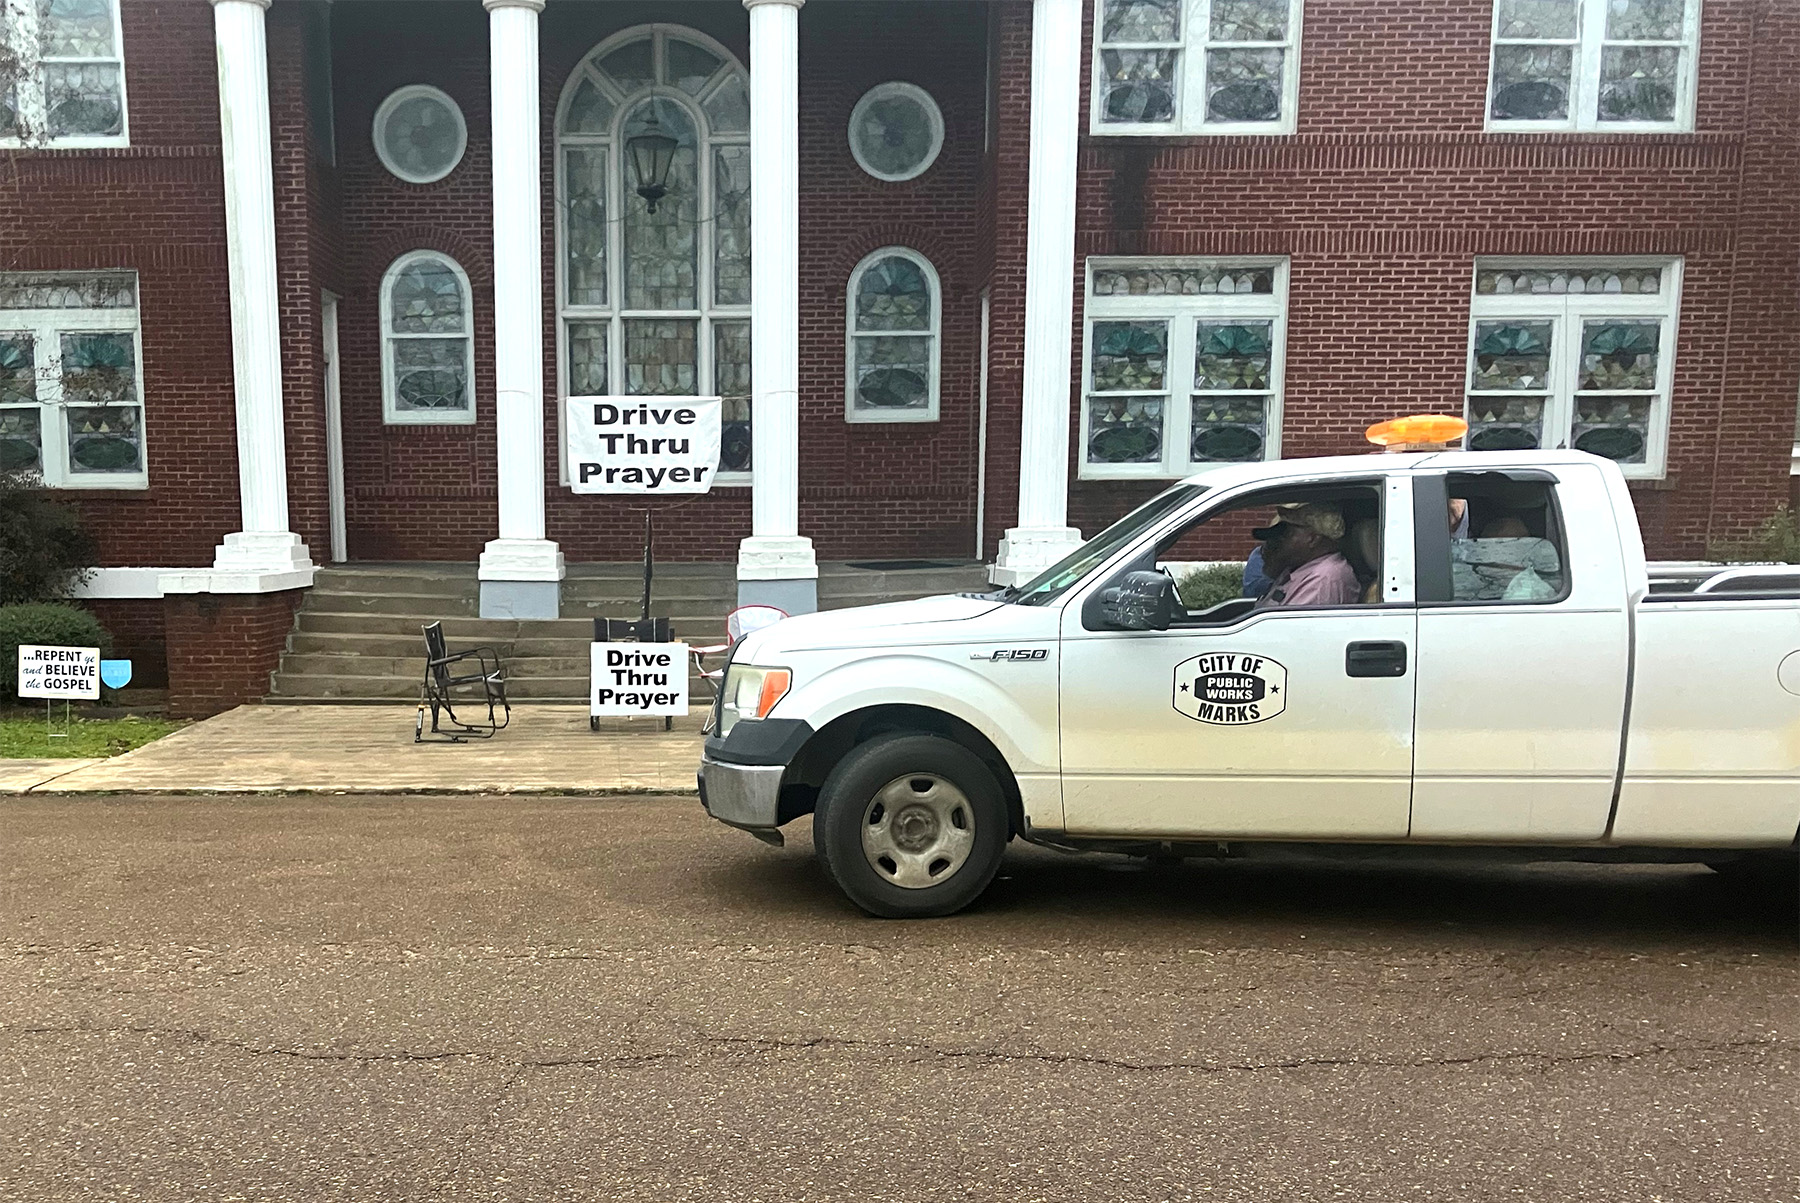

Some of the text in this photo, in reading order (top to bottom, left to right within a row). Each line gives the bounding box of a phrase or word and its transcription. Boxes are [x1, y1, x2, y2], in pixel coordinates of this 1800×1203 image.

[594, 404, 696, 425] Drive
[599, 433, 689, 454] Thru
[579, 463, 708, 488] Prayer
[84, 655, 95, 664] ye
[607, 650, 671, 667] Drive
[990, 649, 1049, 662] F-150
[22, 665, 43, 675] and
[45, 664, 95, 676] BELIEVE
[1199, 655, 1264, 674] CITY OF
[25, 678, 92, 690] the GOSPEL
[611, 669, 667, 686] Thru
[1207, 677, 1254, 688] PUBLIC
[599, 689, 679, 709] Prayer
[1206, 689, 1254, 700] WORKS
[1197, 702, 1261, 722] MARKS
